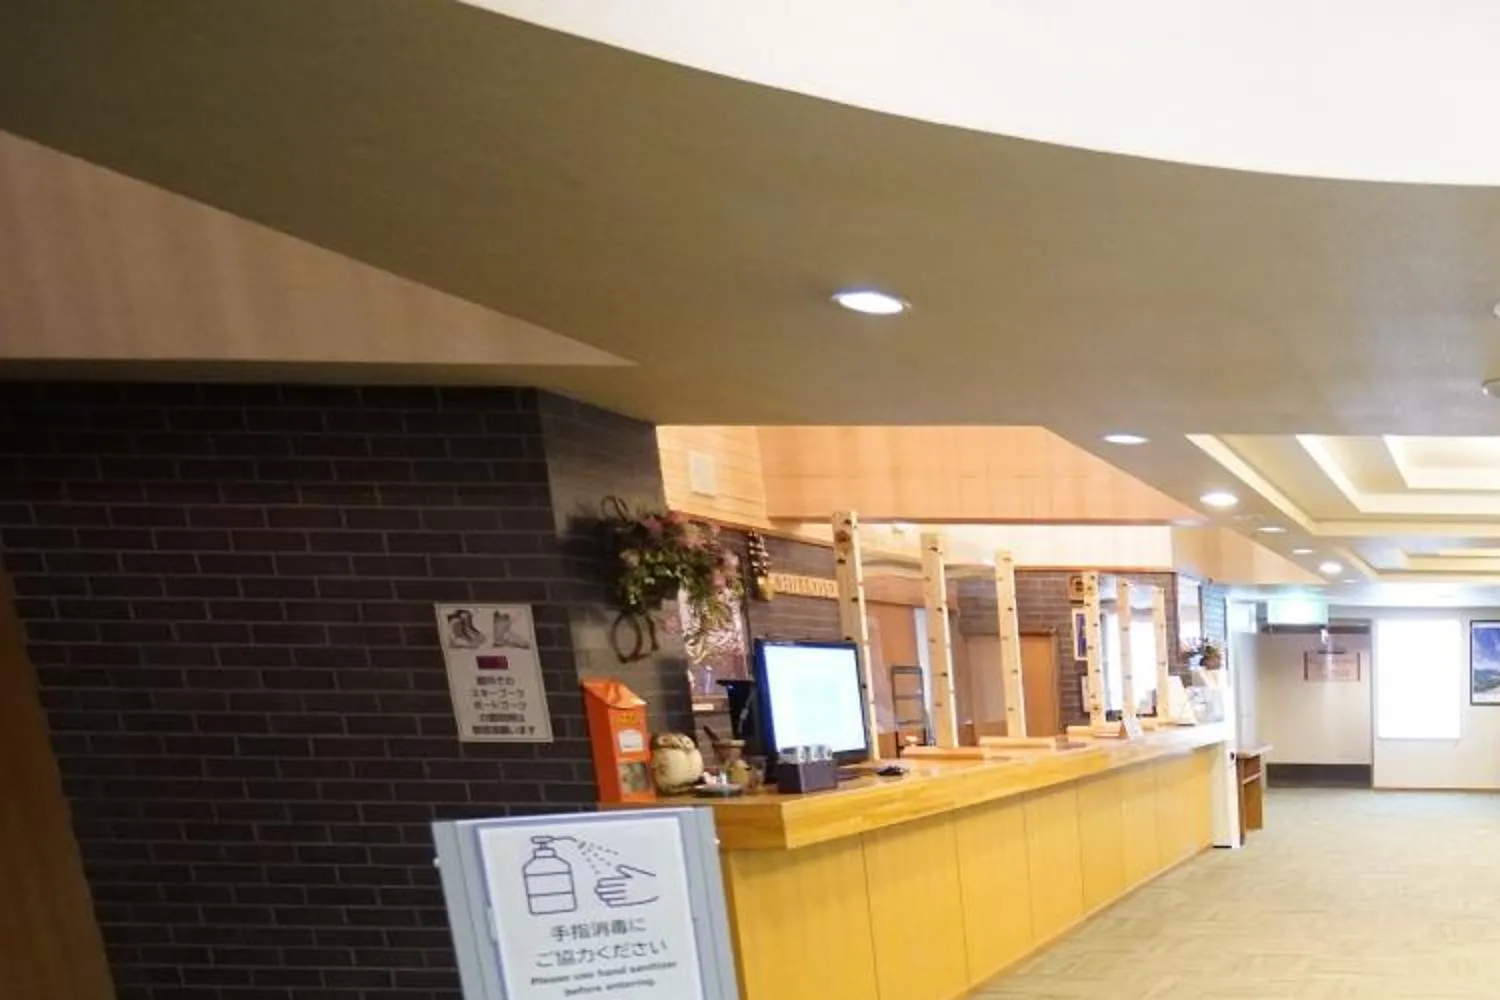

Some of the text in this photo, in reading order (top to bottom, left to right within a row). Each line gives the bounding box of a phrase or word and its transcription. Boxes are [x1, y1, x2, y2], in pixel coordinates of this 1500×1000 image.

[550, 917, 647, 942] 手指消毒に
[535, 938, 668, 967] ご協力ください
